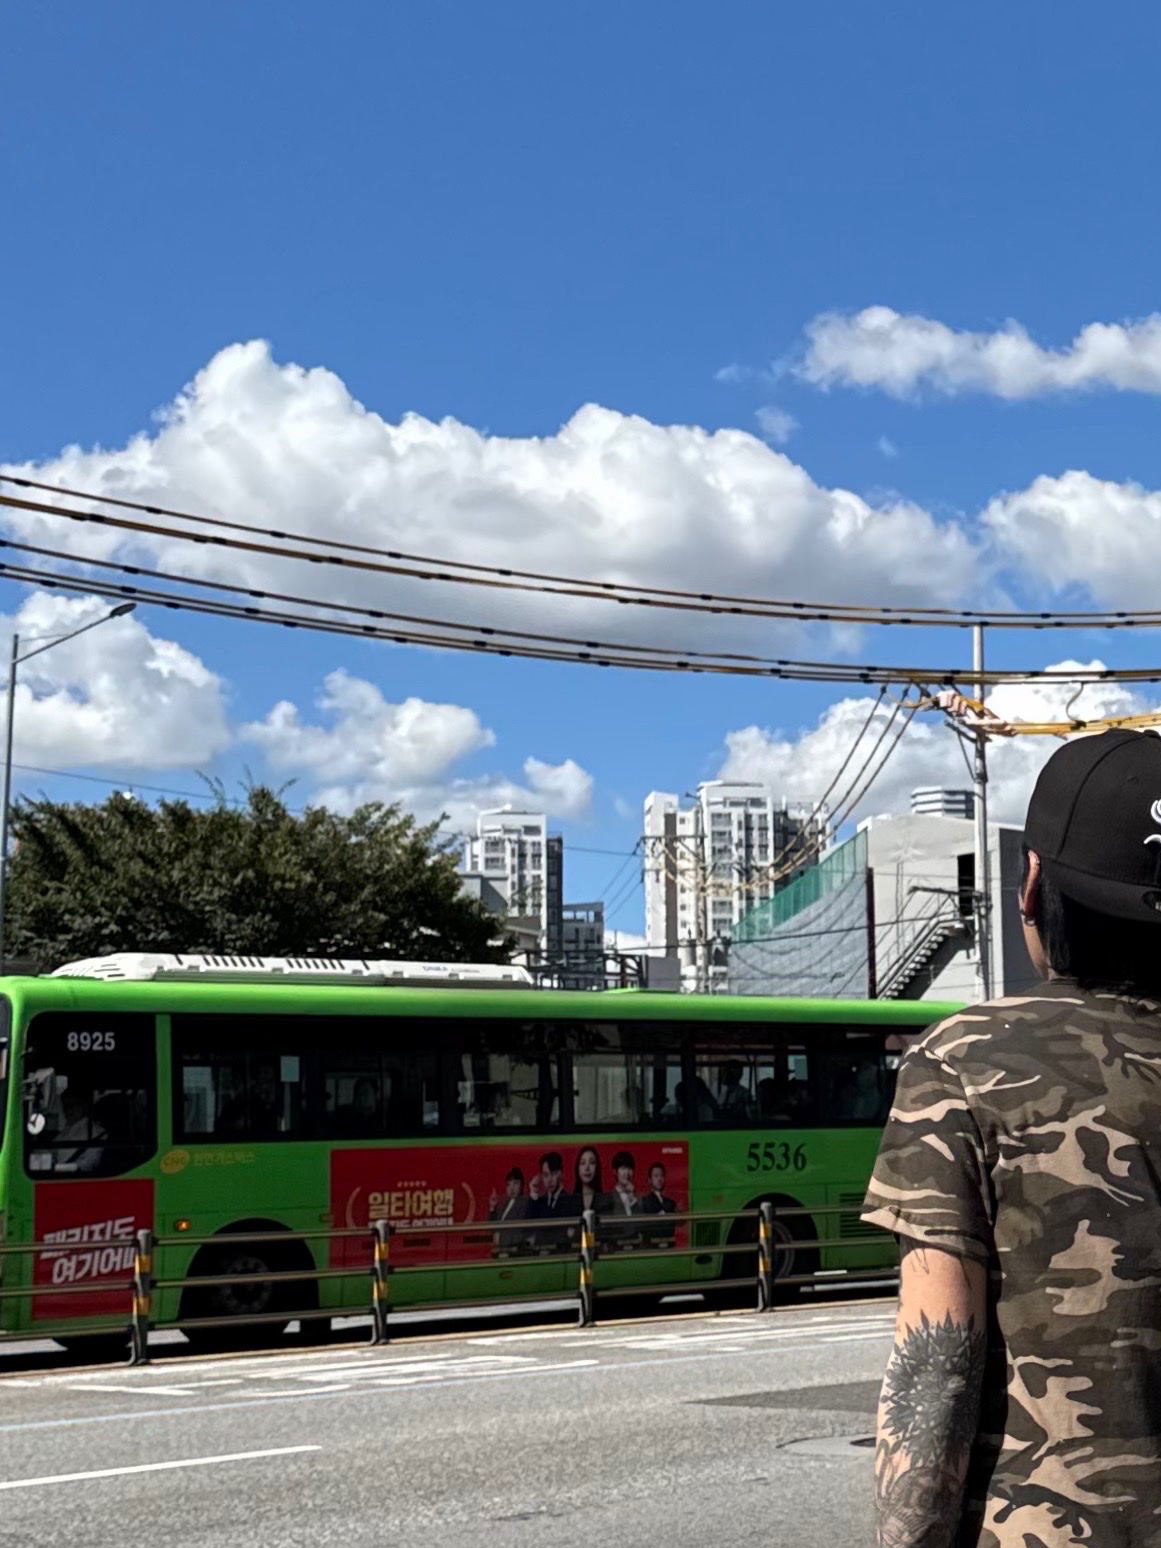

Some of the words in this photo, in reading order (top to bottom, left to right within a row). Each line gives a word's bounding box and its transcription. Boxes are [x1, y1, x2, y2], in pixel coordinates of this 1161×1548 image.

[67, 1031, 116, 1051] 8925
[746, 1142, 808, 1172] 5536
[368, 1189, 455, 1219] 일타여행
